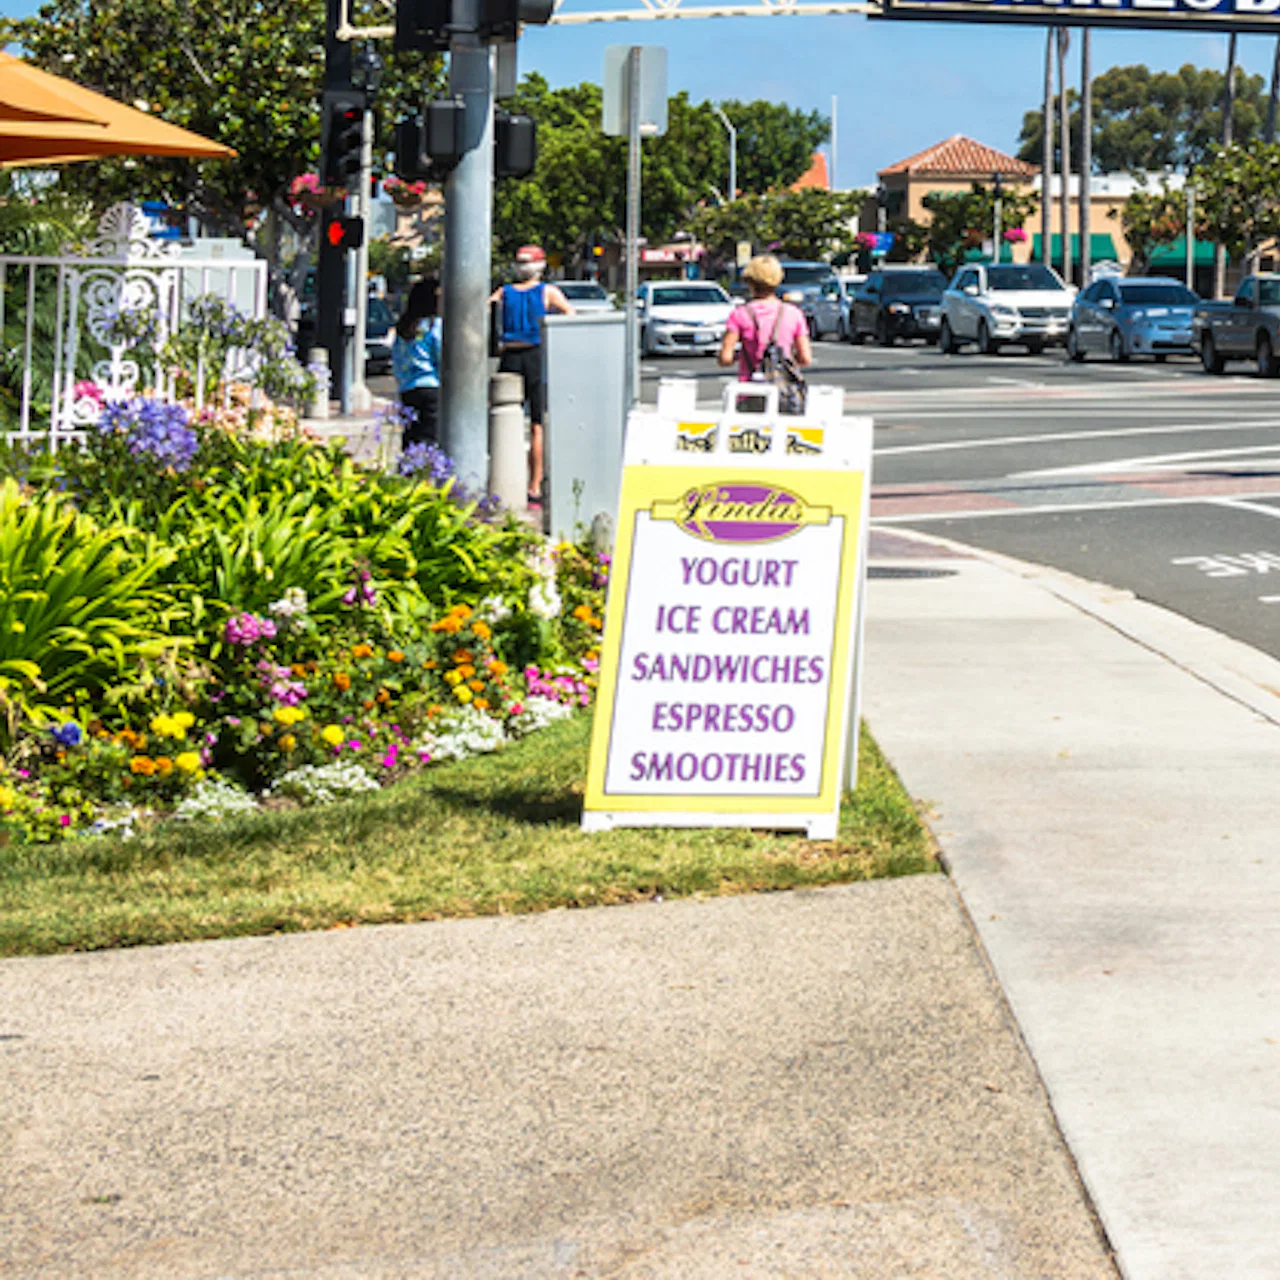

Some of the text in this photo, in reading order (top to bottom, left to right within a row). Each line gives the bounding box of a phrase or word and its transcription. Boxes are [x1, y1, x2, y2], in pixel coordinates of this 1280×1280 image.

[680, 557, 799, 588] YOGURT
[655, 604, 811, 635] ICE CREAM
[631, 652, 825, 684] SANDWICHES
[651, 701, 796, 733] ESPRESSO
[629, 750, 807, 783] SMOOTHIES
